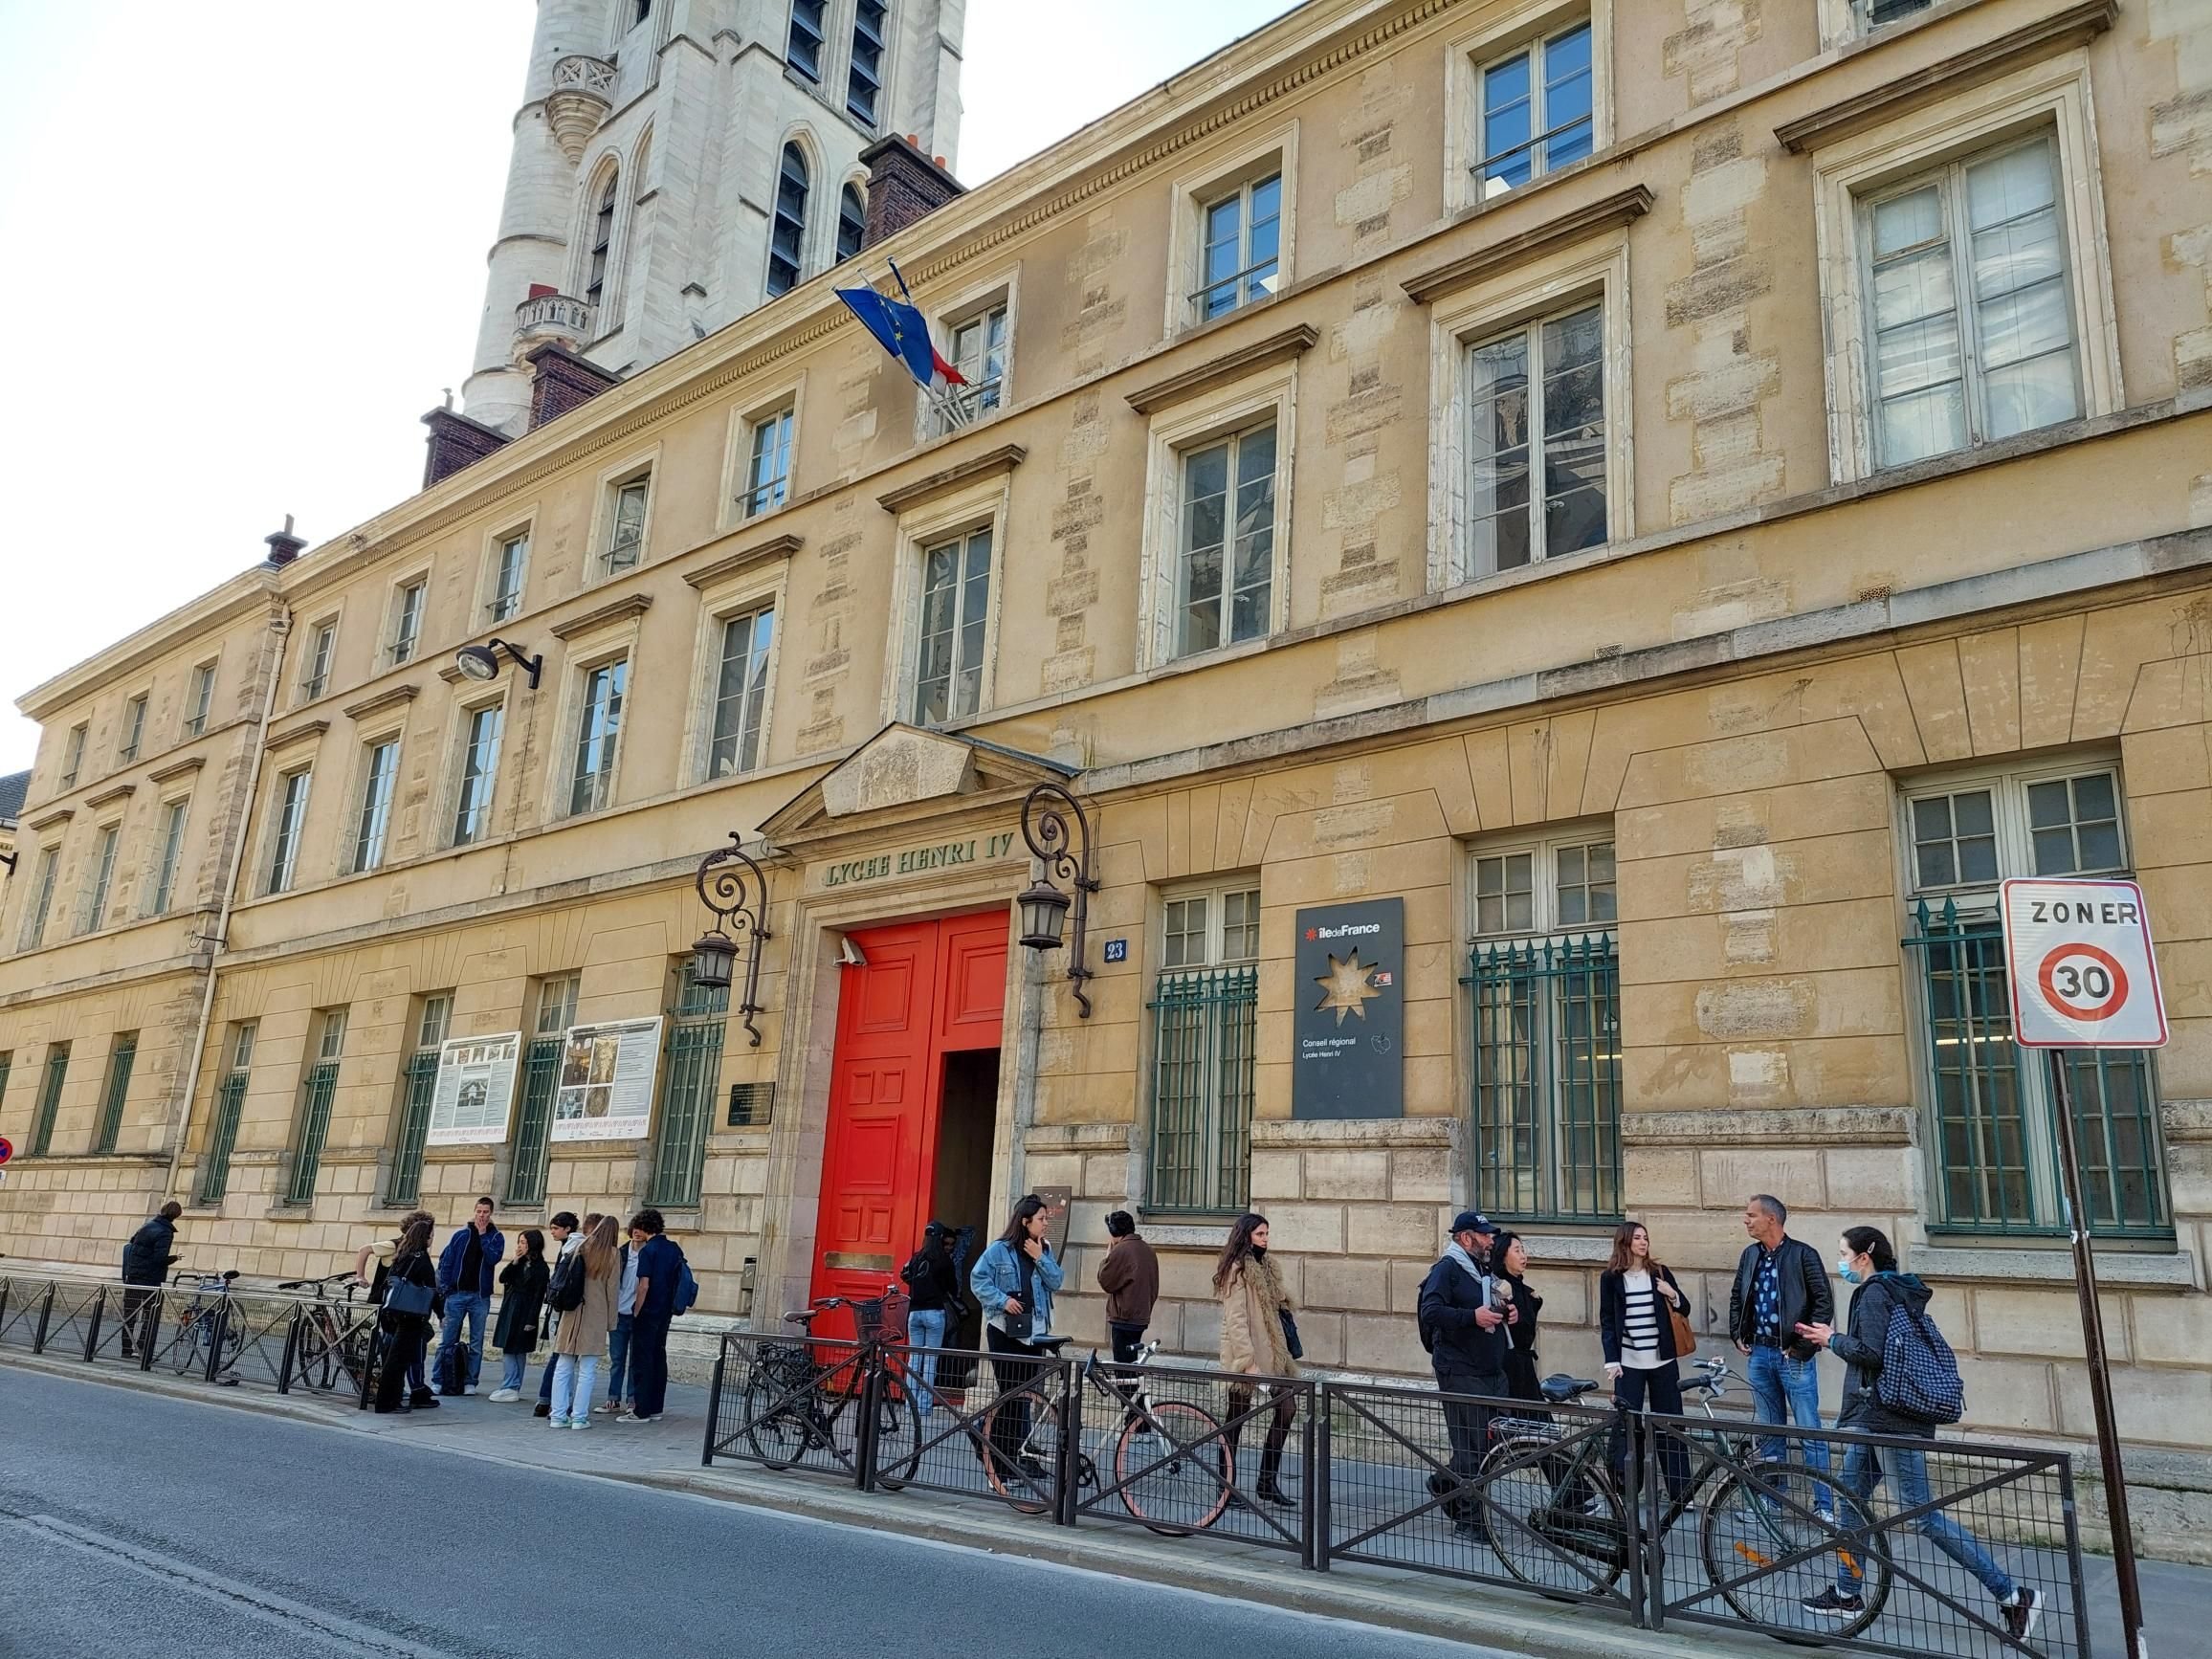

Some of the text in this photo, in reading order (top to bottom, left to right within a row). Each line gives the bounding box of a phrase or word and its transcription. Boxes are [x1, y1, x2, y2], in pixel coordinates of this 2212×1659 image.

[896, 839, 977, 874] HENRI
[984, 831, 1015, 859] IV
[1106, 942, 1123, 960] 23
[2056, 965, 2111, 999] 30
[1302, 1036, 1357, 1048] Conseil régional
[1302, 1051, 1318, 1060] Lycée
